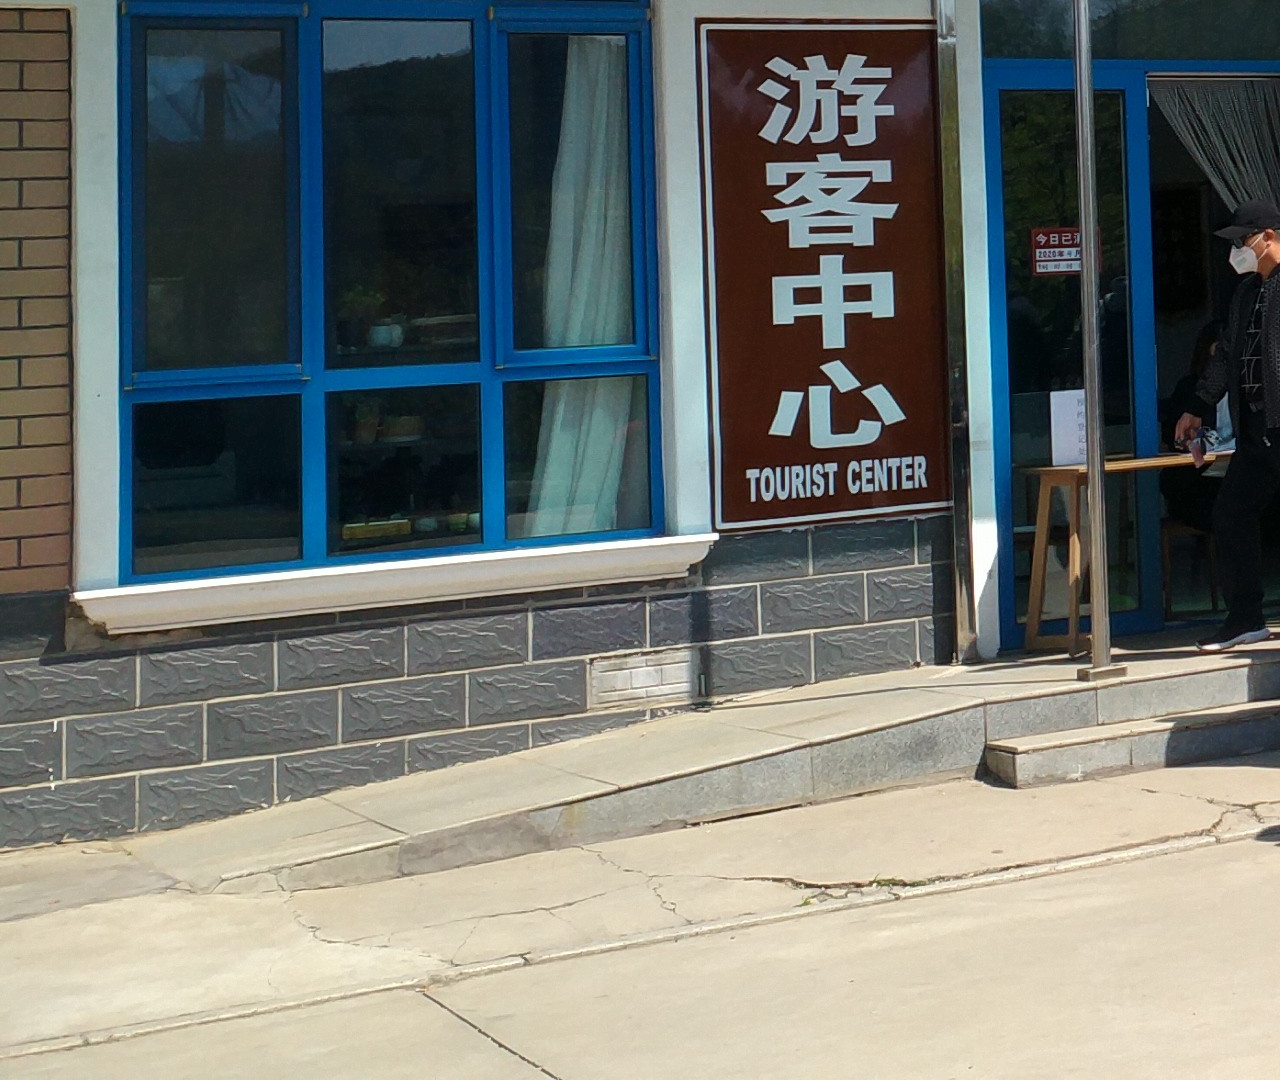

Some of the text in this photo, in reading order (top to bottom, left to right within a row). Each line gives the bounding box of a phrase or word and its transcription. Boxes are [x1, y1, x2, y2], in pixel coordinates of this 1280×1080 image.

[757, 53, 907, 449] 游客中心
[746, 455, 928, 503] TOURIST CENTER
